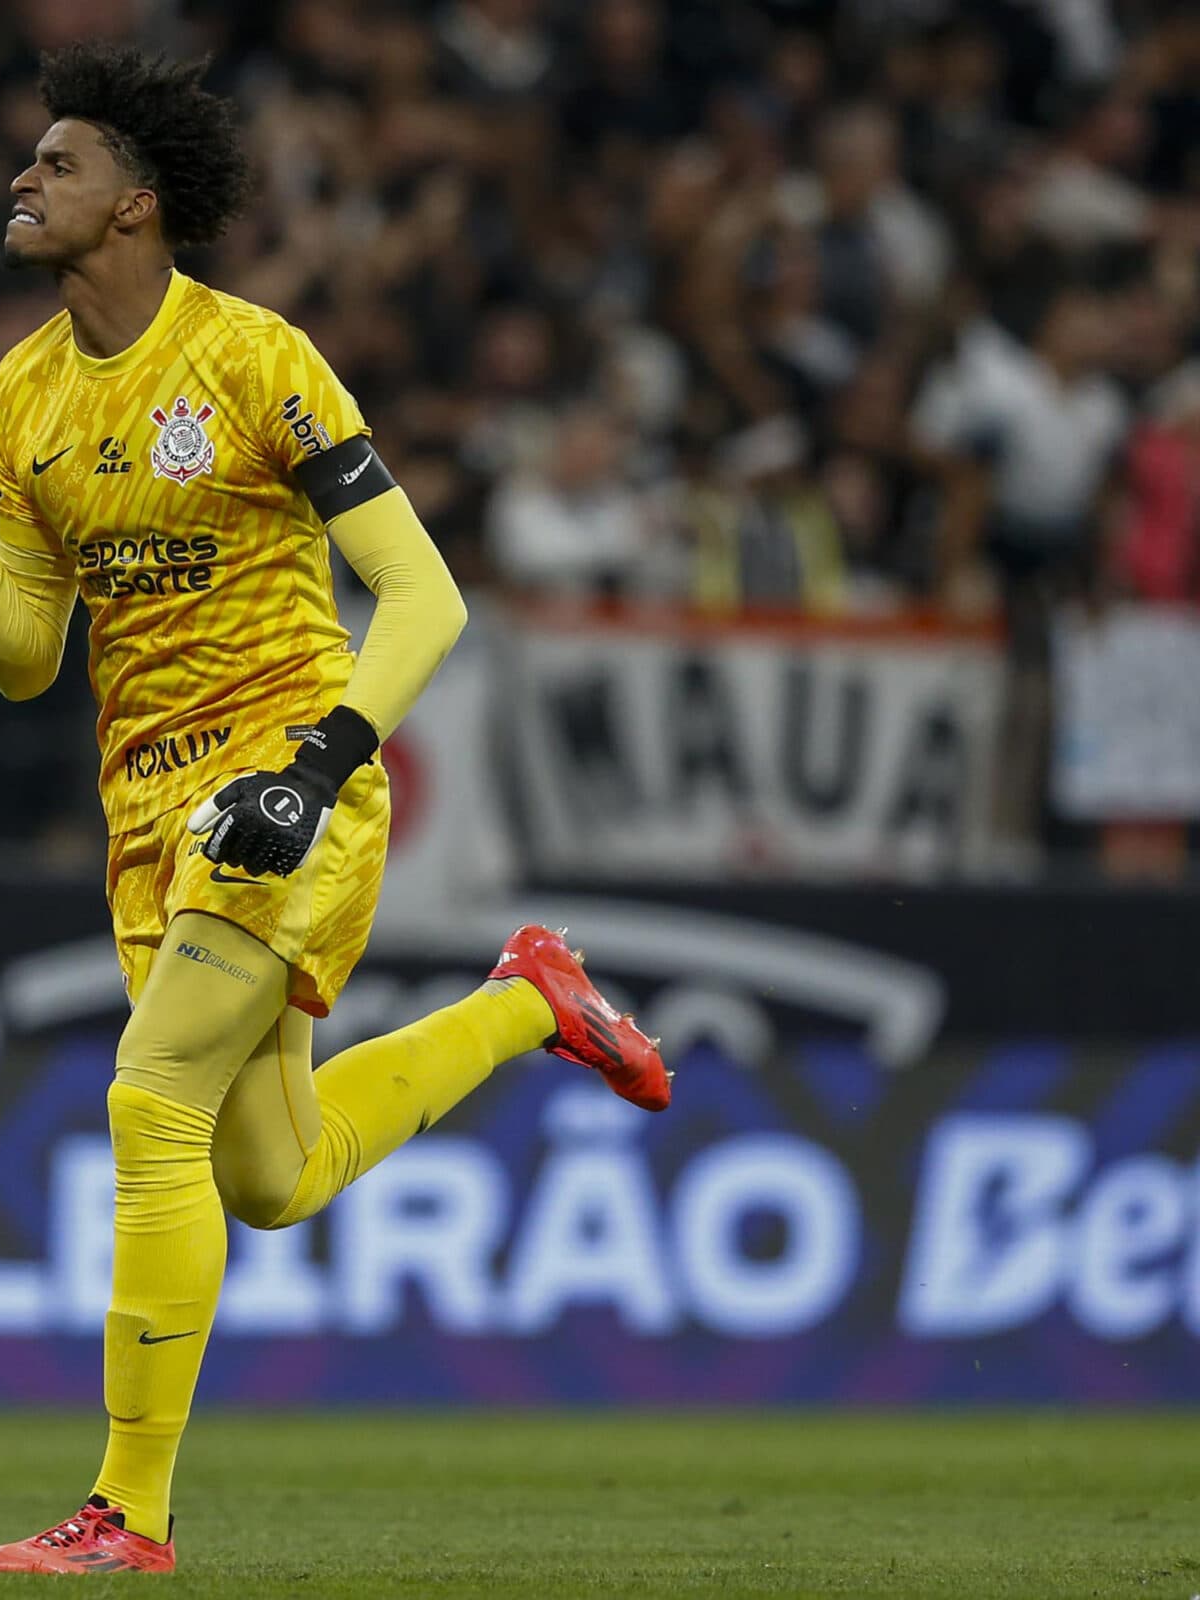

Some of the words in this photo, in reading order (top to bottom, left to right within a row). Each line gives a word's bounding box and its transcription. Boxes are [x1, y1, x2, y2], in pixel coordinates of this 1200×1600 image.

[94, 461, 133, 474] ALE
[68, 531, 219, 571] sportes
[897, 1112, 1200, 1342] Be
